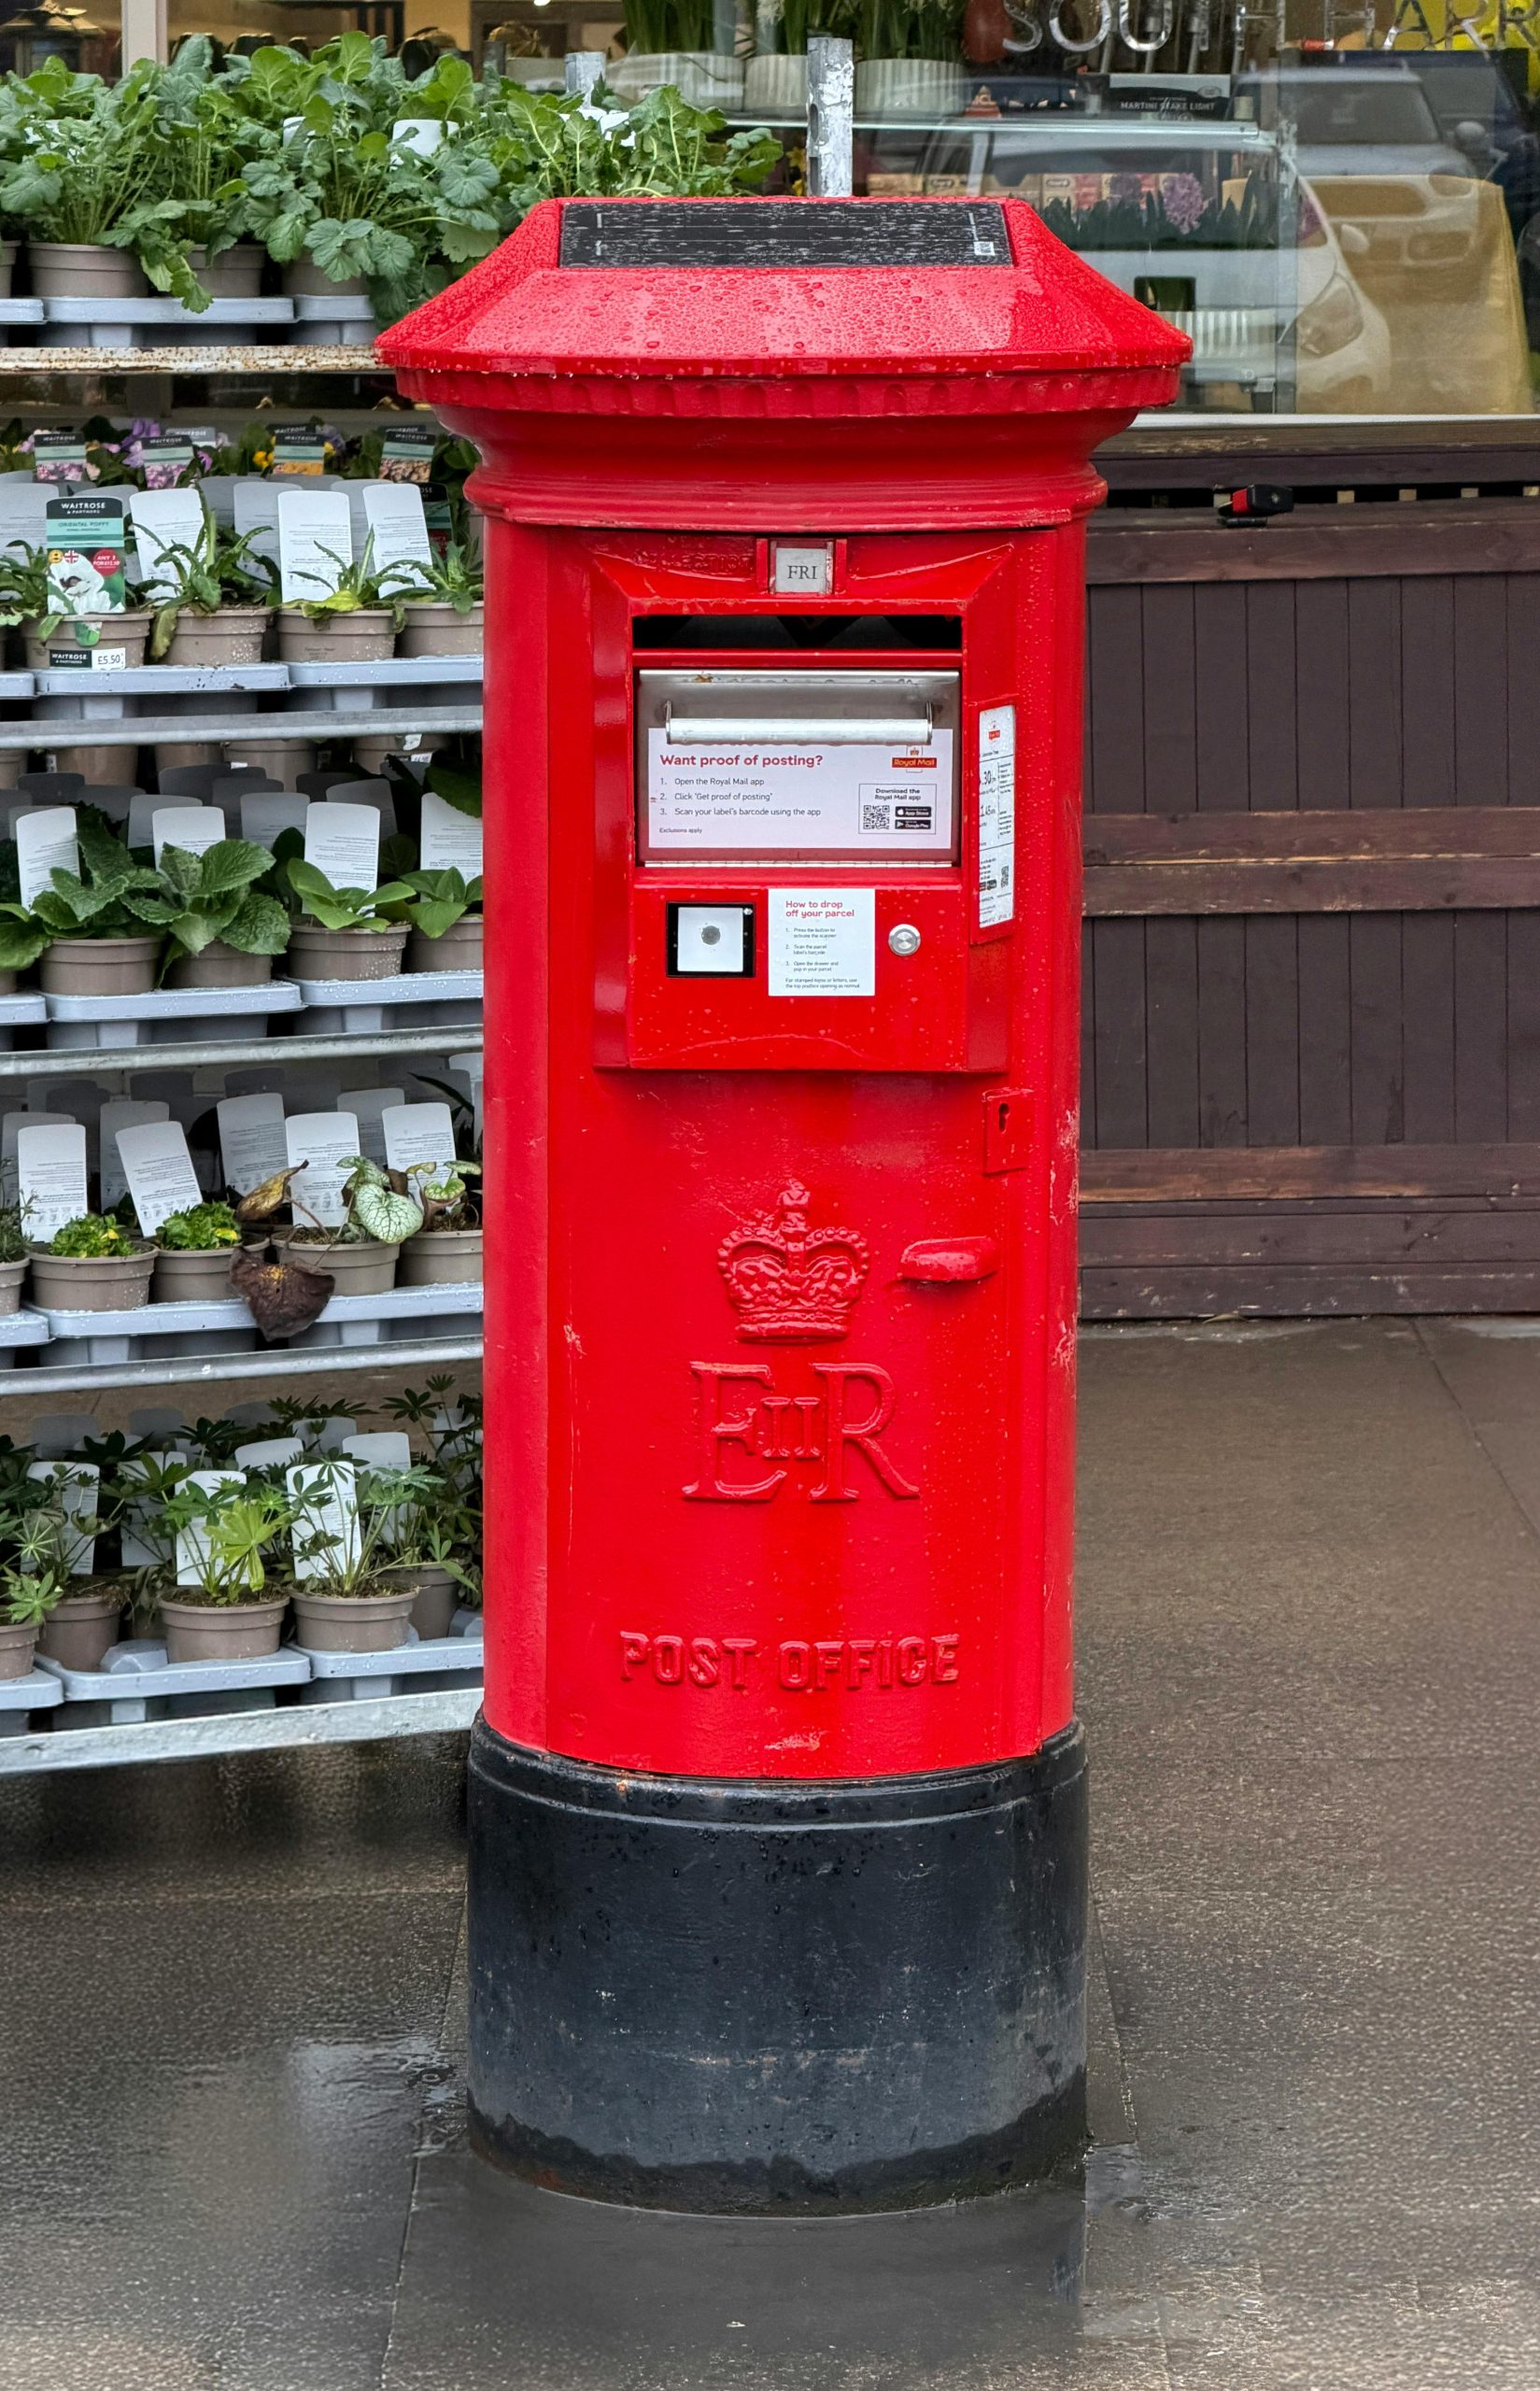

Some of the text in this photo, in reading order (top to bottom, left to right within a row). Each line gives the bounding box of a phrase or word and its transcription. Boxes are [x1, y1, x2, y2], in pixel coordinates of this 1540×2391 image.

[1190, 102, 1214, 110] LIGHT
[786, 564, 818, 581] FRI
[97, 655, 120, 665] £5.50
[660, 755, 823, 768] Want proof of posting?
[894, 758, 915, 767] Royal
[674, 778, 694, 787] Open
[710, 778, 730, 787] Royal
[750, 779, 764, 787] app
[712, 793, 732, 802] proof
[695, 809, 712, 817] your
[770, 808, 791, 817] using
[807, 809, 821, 817] app
[820, 899, 843, 909] drop
[800, 911, 823, 919] your
[825, 909, 855, 918] parcel
[619, 1630, 960, 1691] POST OFFICE
